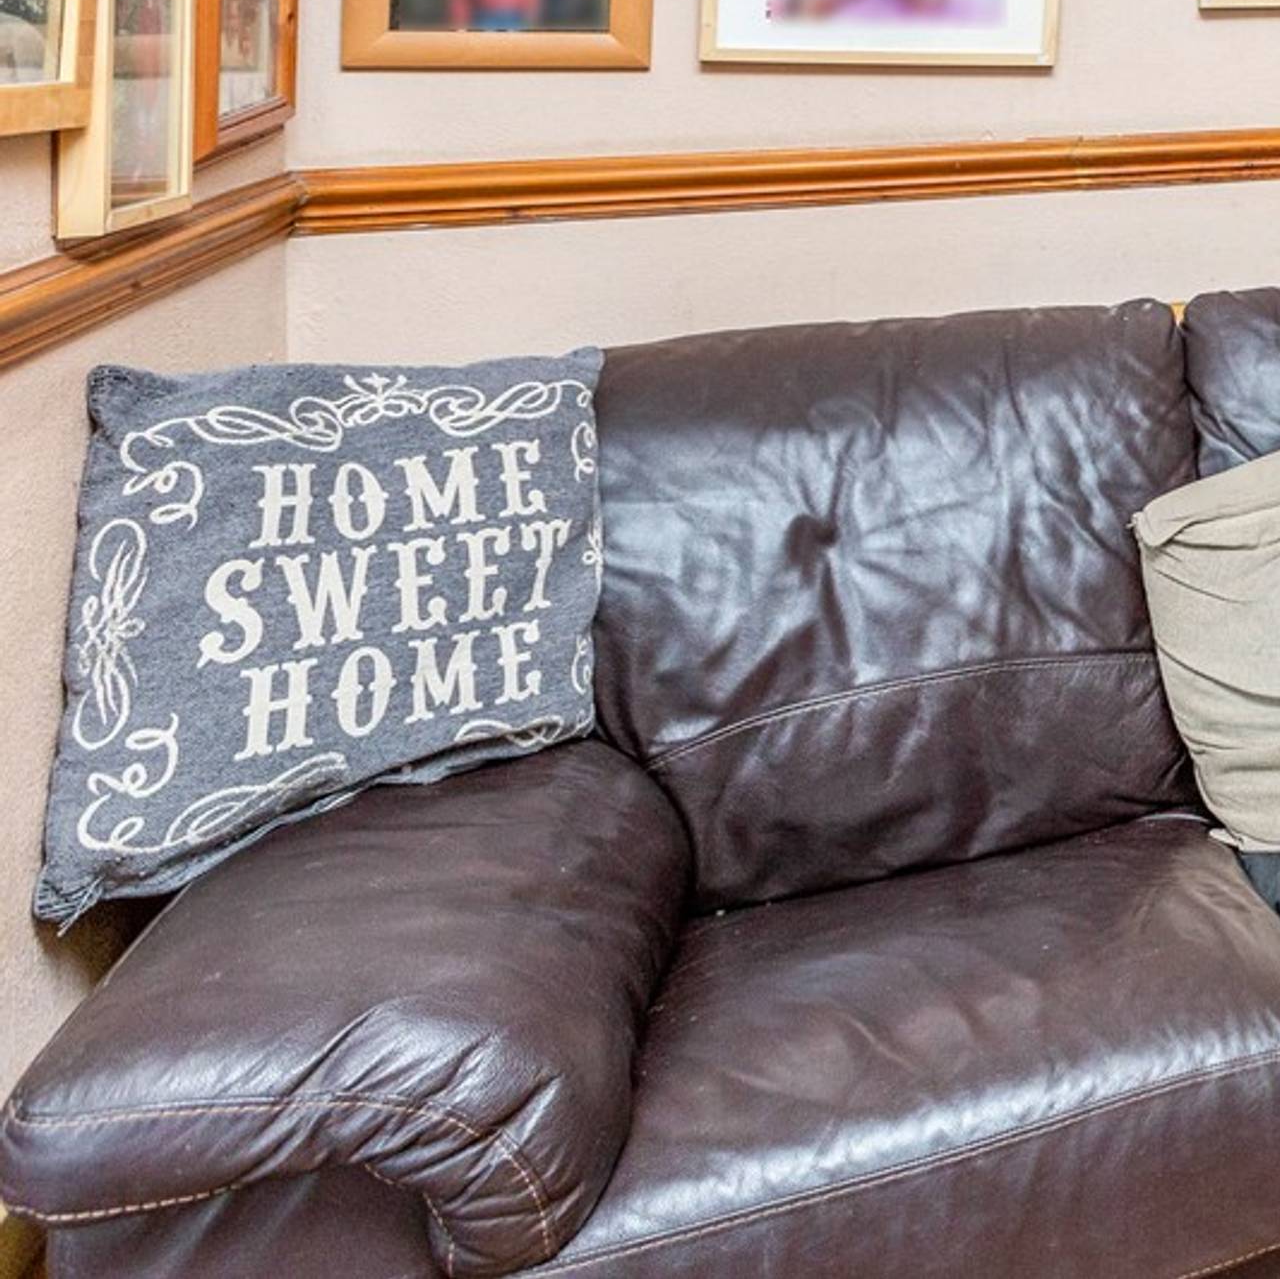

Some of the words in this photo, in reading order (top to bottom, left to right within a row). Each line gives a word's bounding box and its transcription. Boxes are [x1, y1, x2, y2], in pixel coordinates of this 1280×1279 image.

[249, 439, 548, 549] HOME
[197, 518, 573, 669] SWEET
[234, 619, 542, 761] HOME
